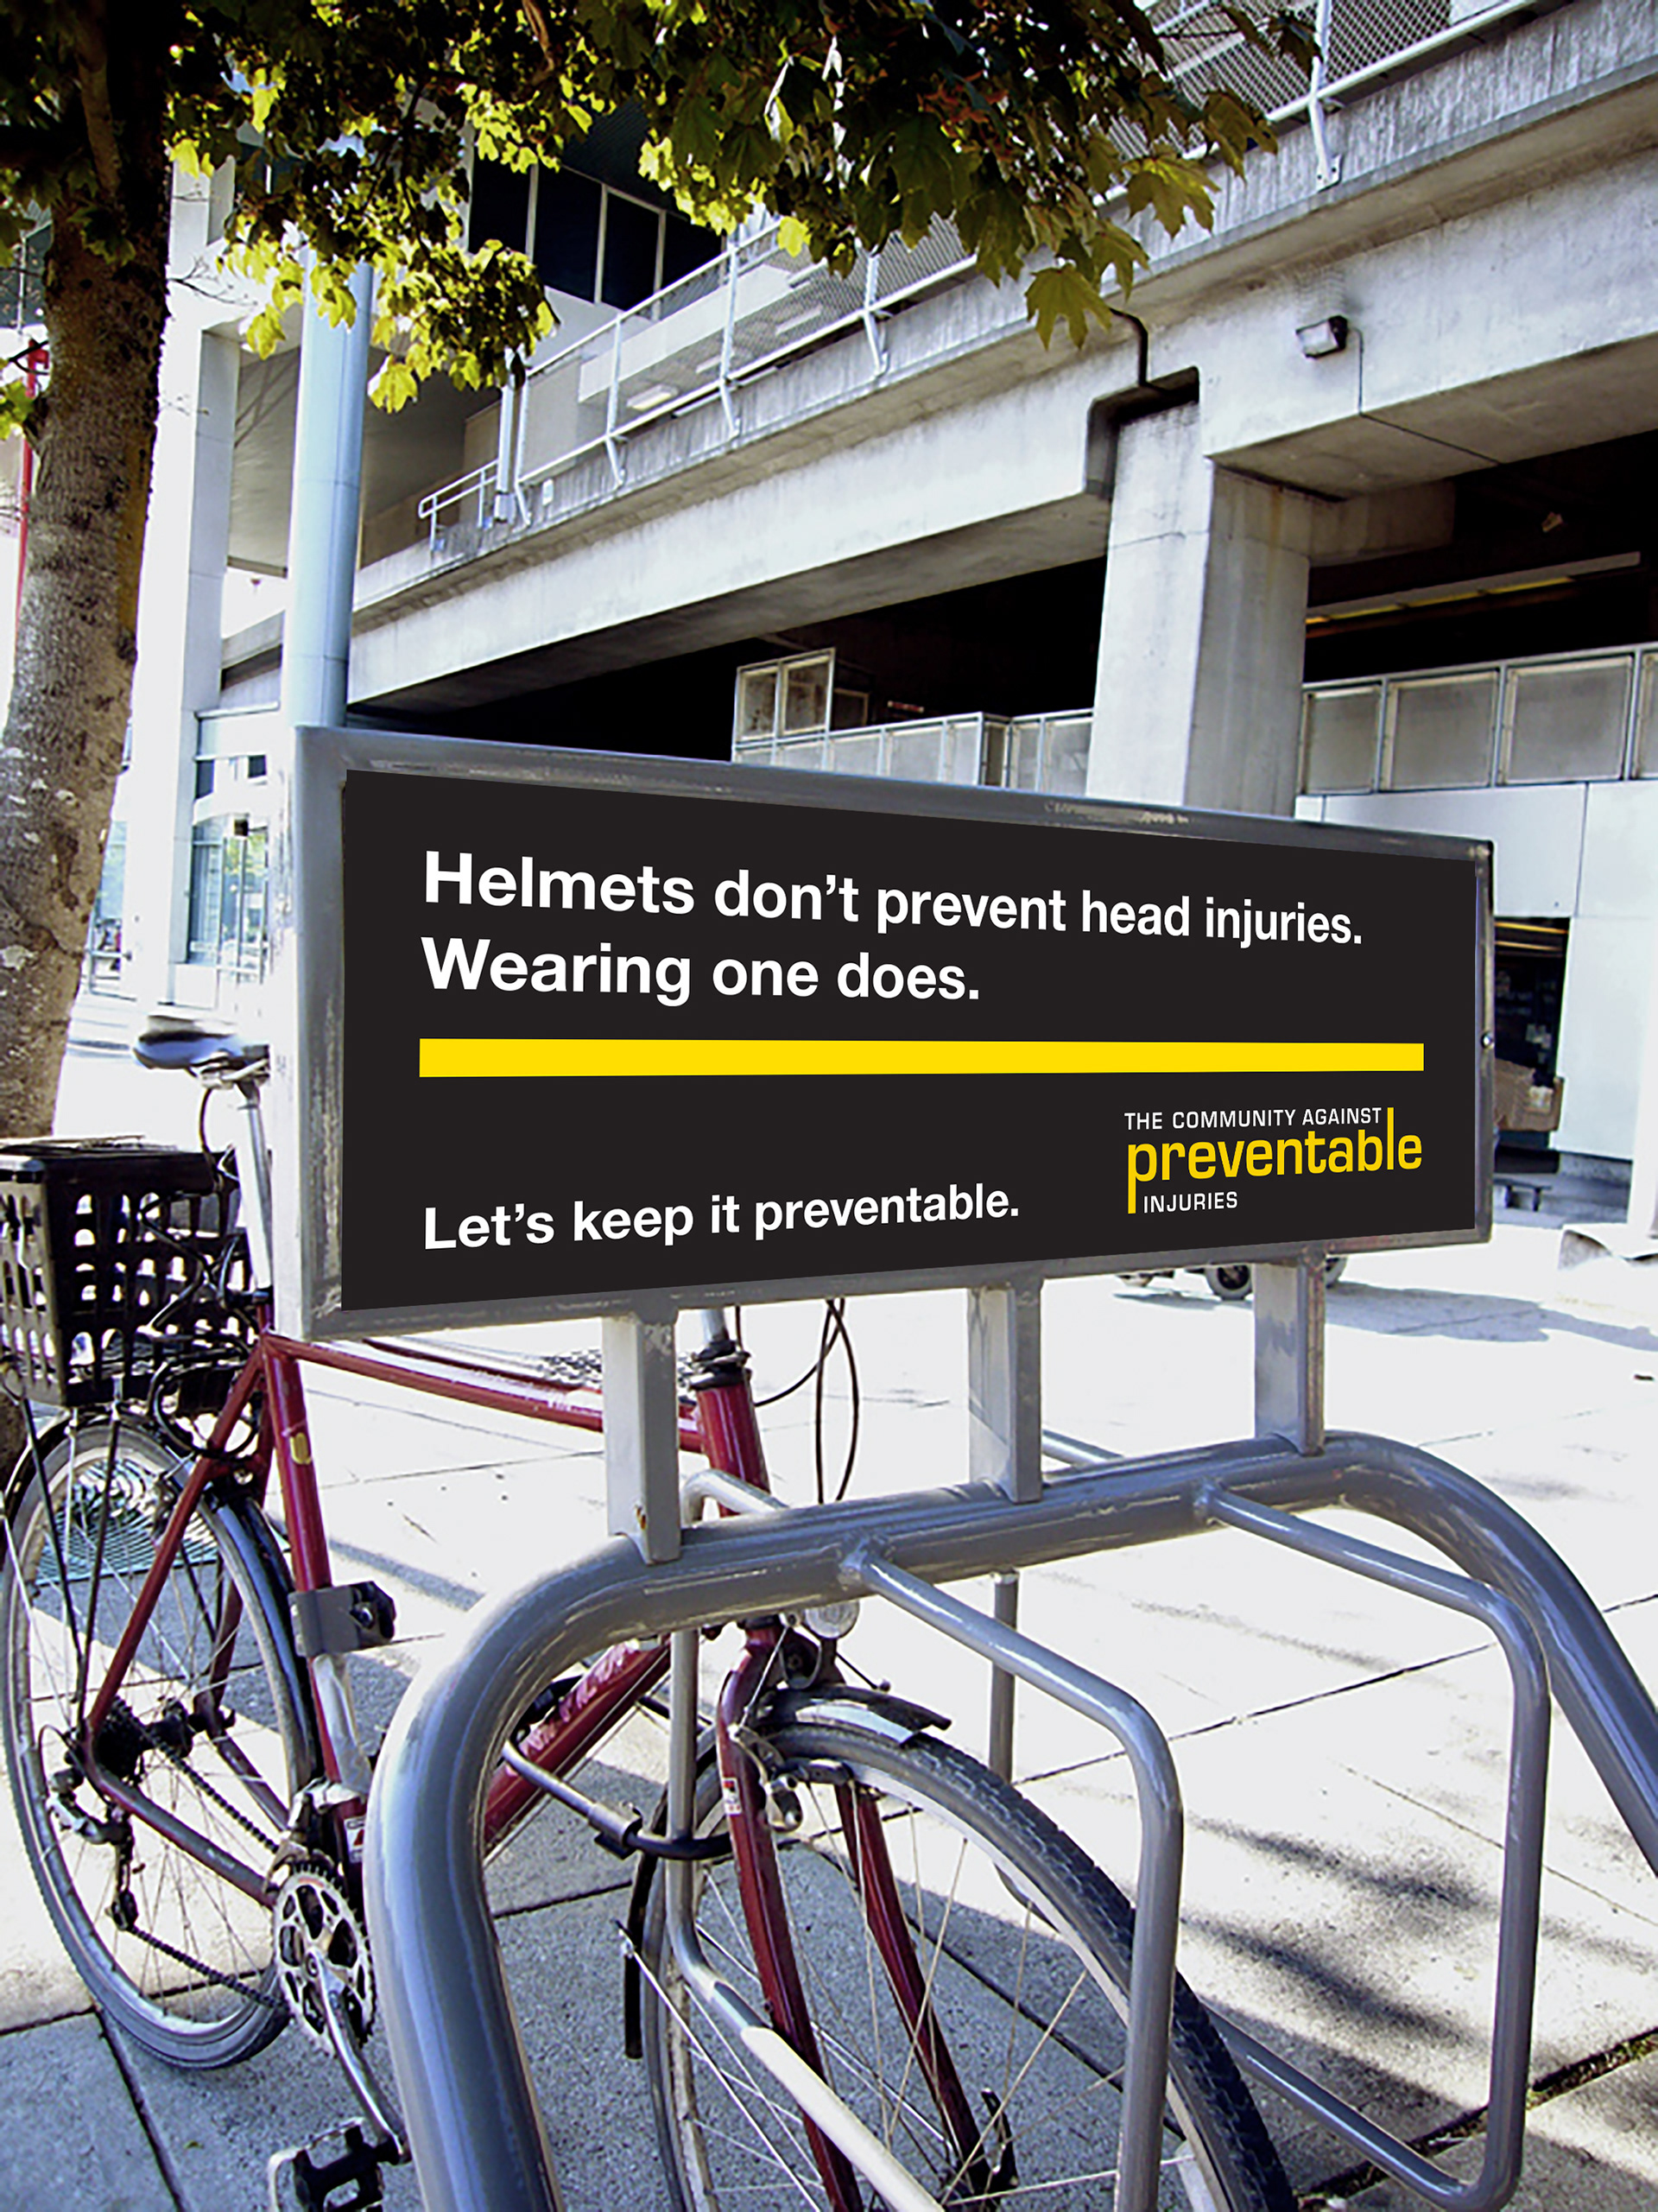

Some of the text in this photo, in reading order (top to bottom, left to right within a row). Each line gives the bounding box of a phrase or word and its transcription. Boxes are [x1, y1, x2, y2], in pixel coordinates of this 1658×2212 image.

[425, 850, 1362, 949] Helmets don’t prevent head injuries.
[420, 936, 979, 1007] Wearing one does.
[1123, 1106, 1382, 1131] THE COMMUNITY AGAINST
[1127, 1106, 1422, 1214] preventable
[425, 1183, 1019, 1250] Let’s keep it preventable.
[1143, 1190, 1238, 1214] INJURIES
